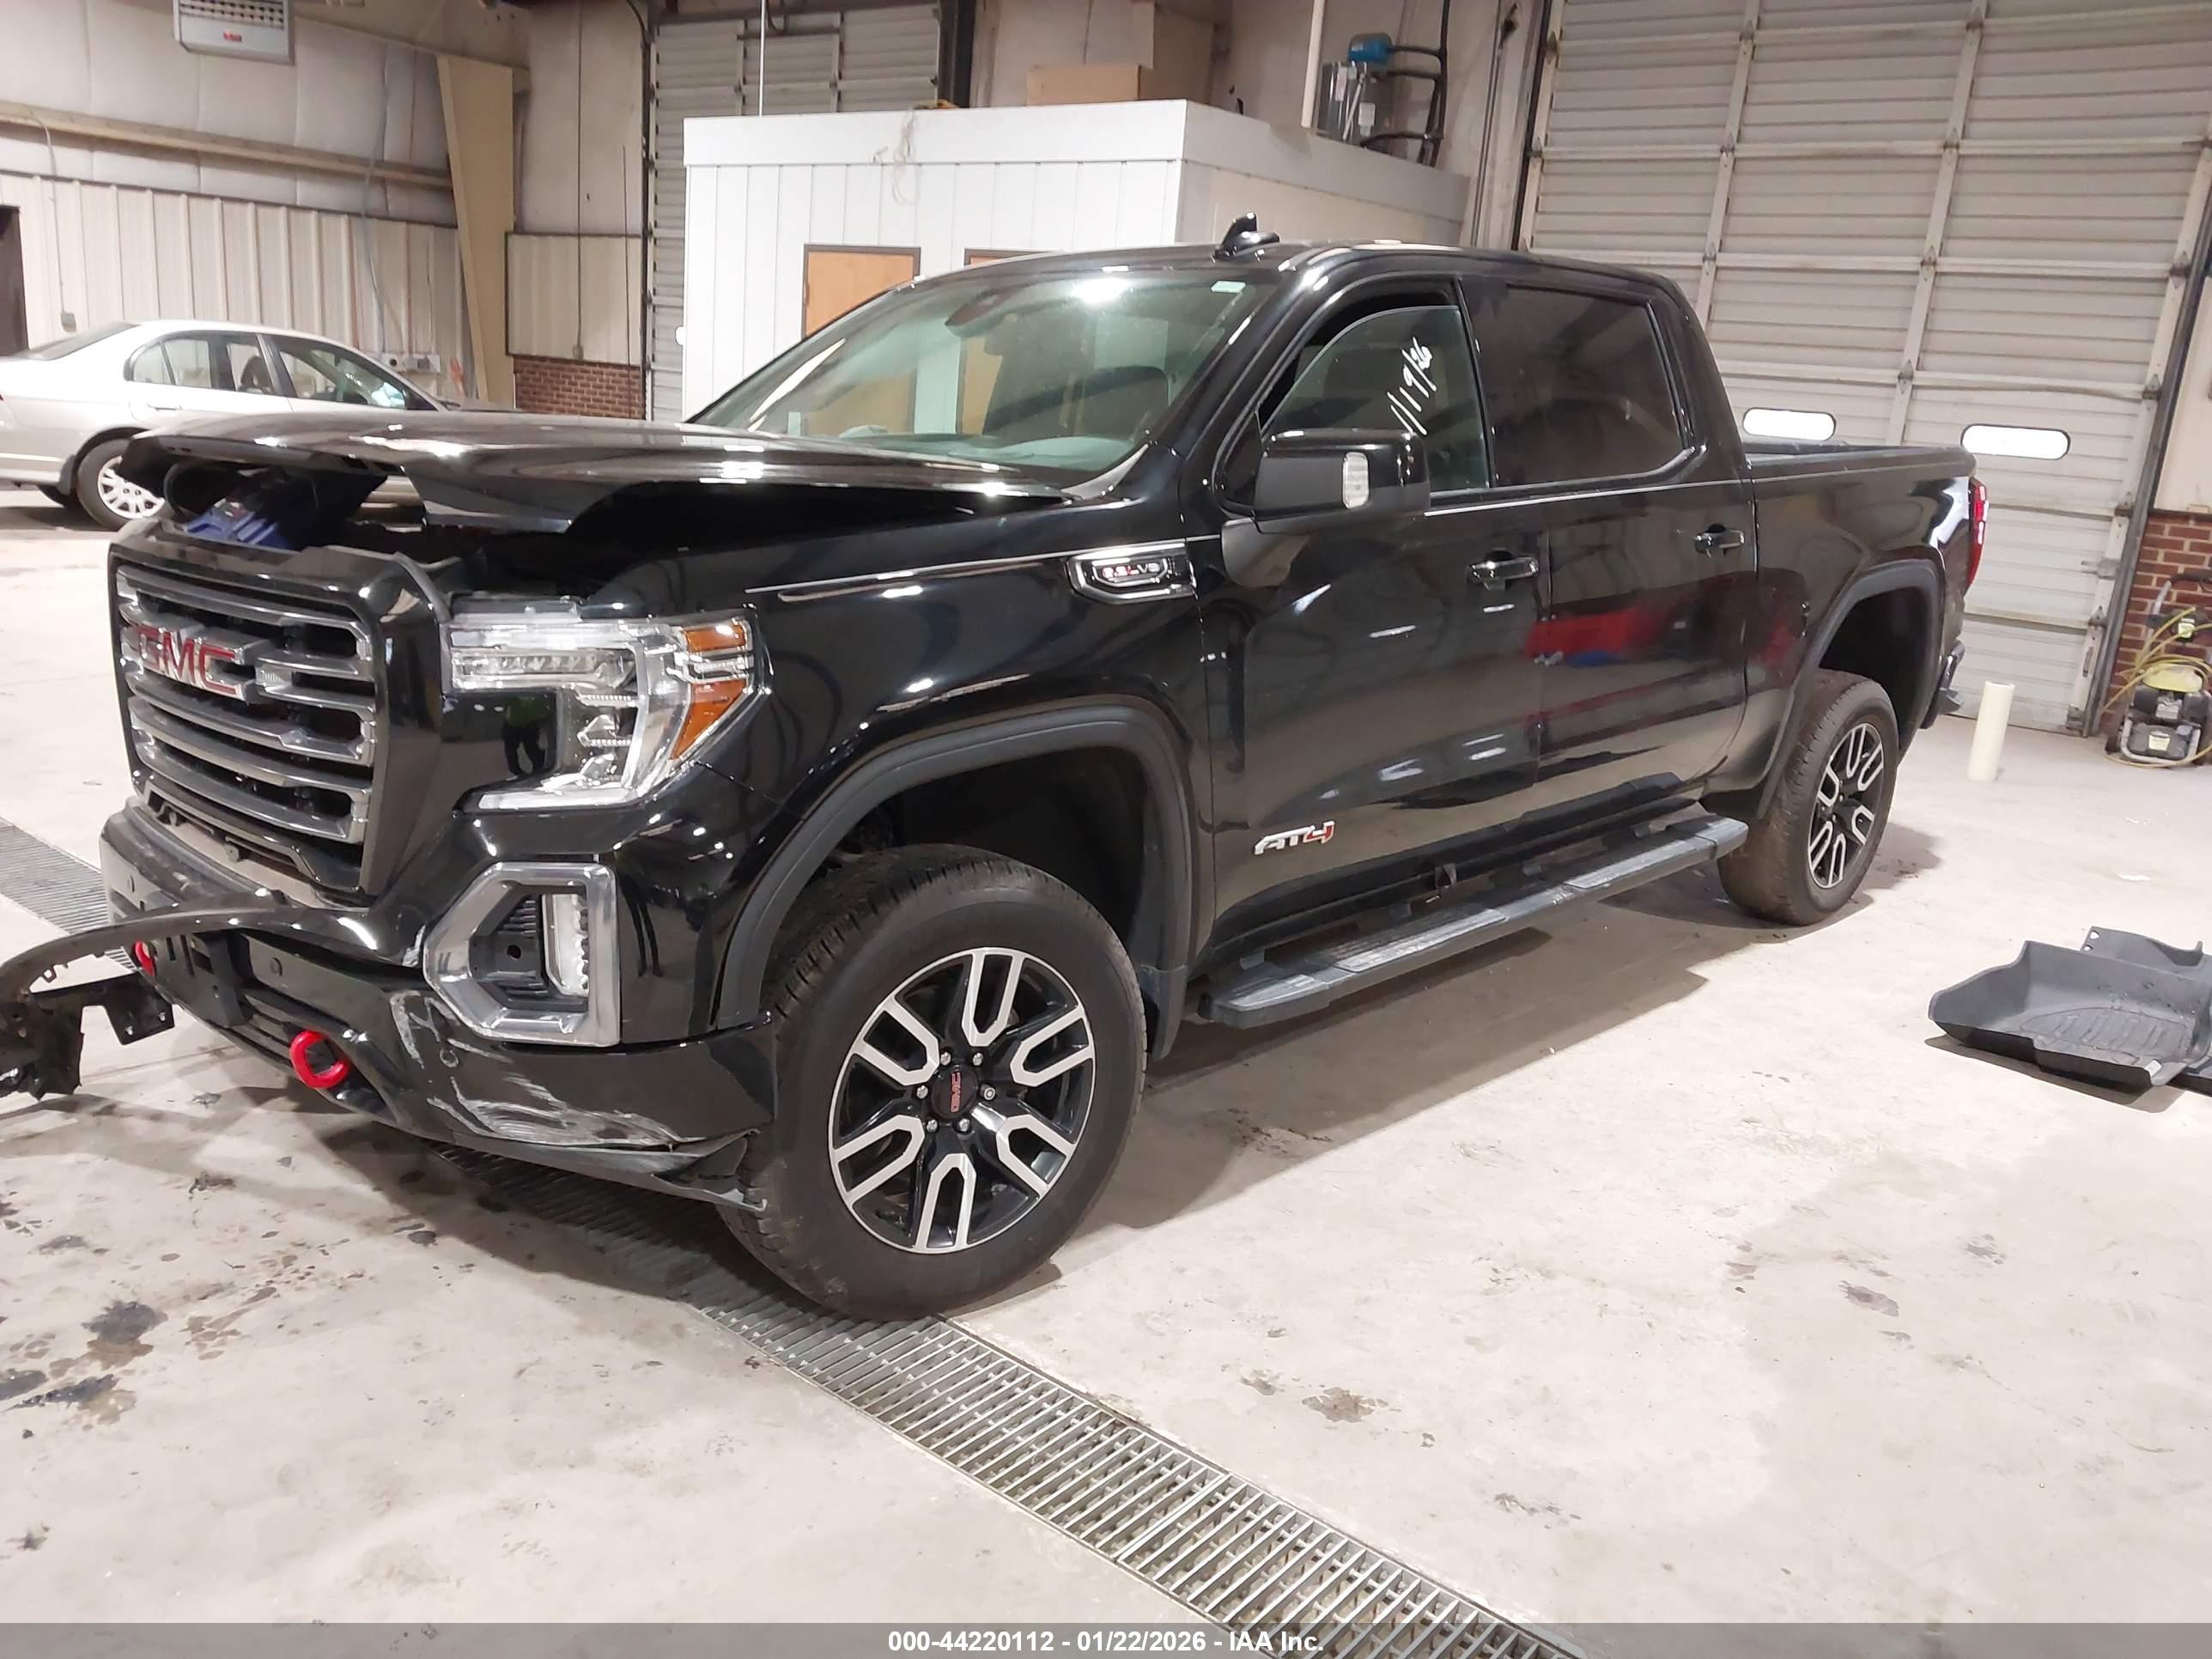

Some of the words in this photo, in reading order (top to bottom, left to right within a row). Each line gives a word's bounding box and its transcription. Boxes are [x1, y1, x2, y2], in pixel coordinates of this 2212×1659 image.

[136, 623, 240, 698] GMC
[1255, 820, 1334, 854] AT4
[951, 1072, 961, 1113] GMC
